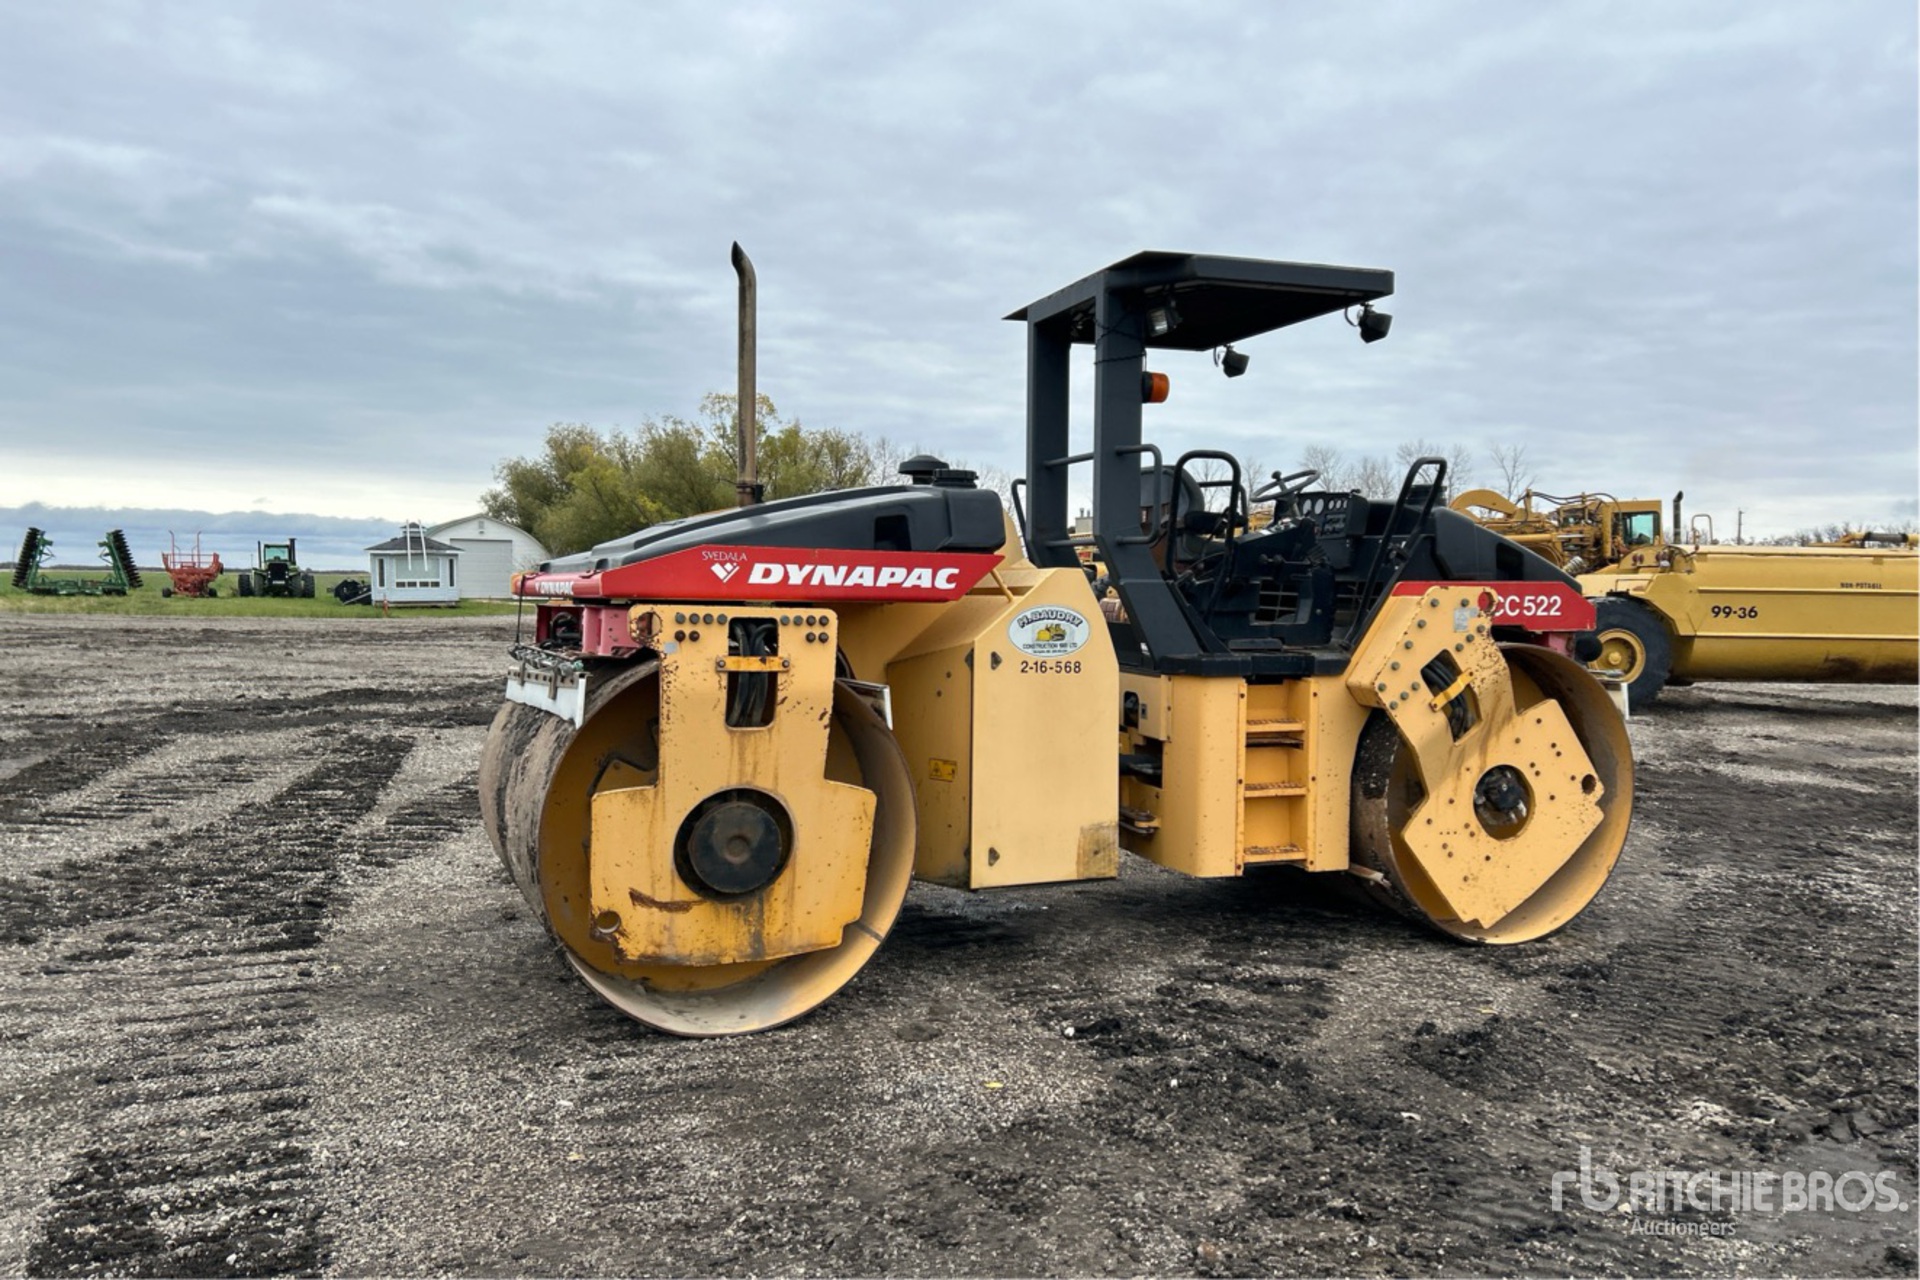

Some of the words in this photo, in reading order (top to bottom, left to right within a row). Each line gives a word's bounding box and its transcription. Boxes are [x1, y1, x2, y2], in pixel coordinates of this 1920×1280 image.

[701, 551, 748, 561] SVEDALA
[748, 563, 960, 590] DYNAPAC
[1523, 595, 1562, 616] 522
[1711, 605, 1759, 619] 99-36
[1020, 660, 1082, 674] 2-16-568
